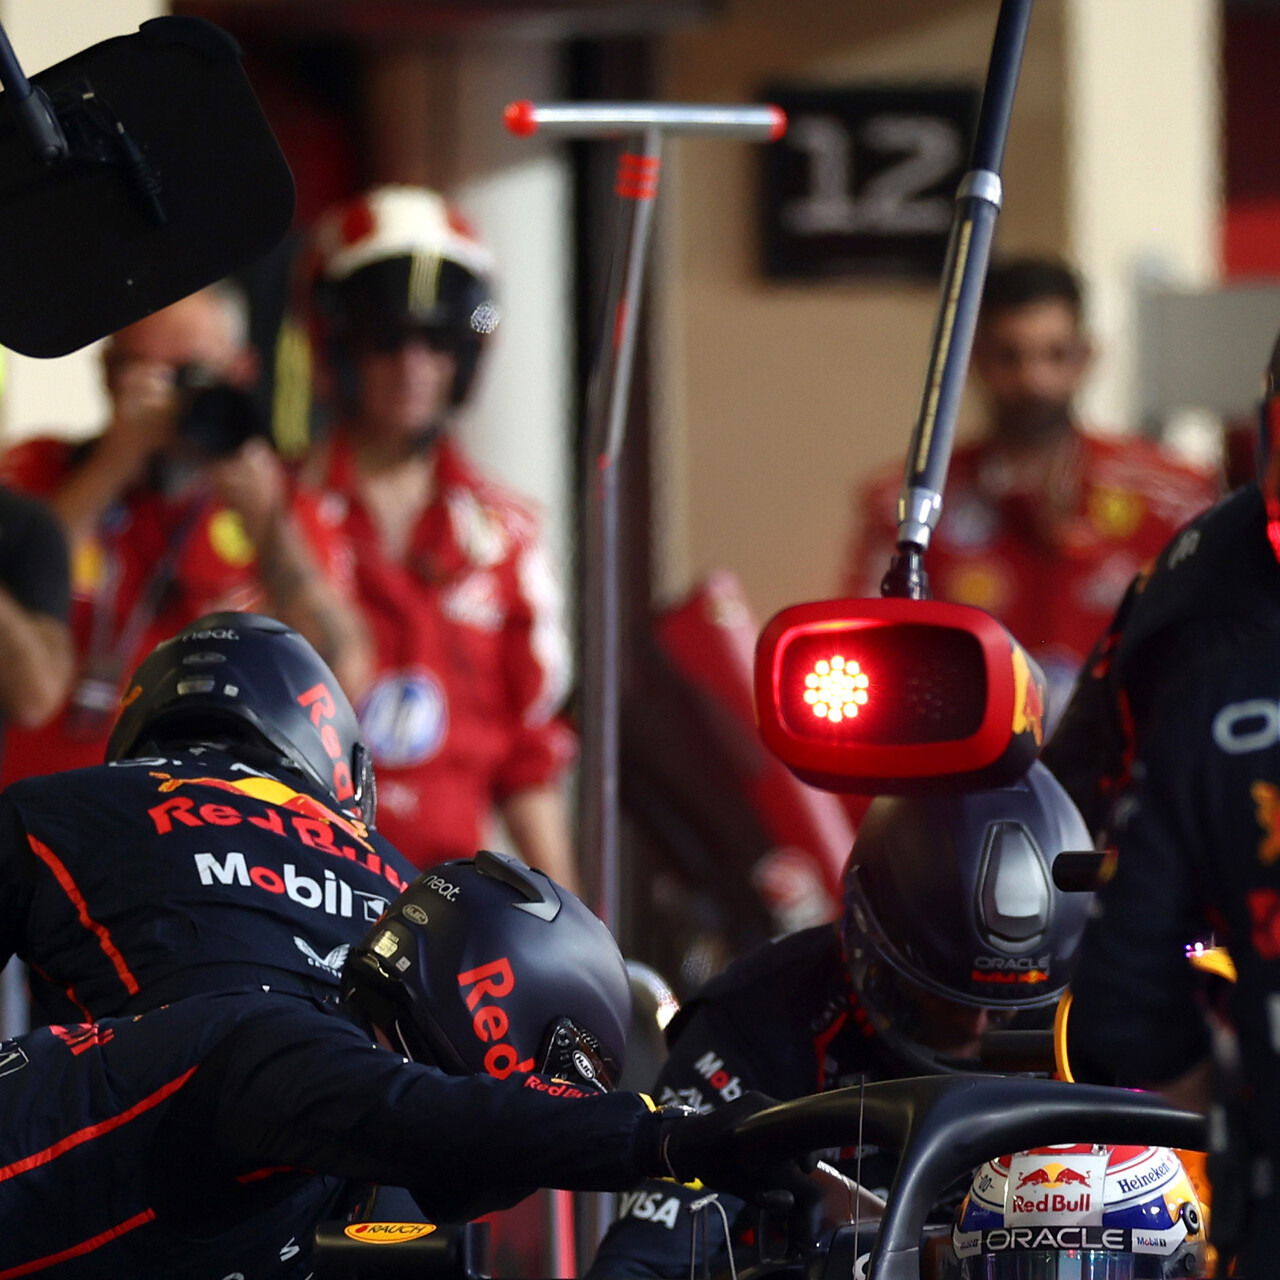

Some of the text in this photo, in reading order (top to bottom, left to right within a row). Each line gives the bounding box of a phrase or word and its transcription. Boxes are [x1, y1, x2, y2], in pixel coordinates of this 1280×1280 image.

[782, 112, 960, 232] 12
[194, 852, 352, 918] Mobil
[422, 873, 459, 902] neat.
[974, 956, 1049, 970] ORACLE
[457, 957, 536, 1081] Red
[524, 1075, 564, 1098] Red
[694, 1051, 742, 1101] Mob
[1116, 1161, 1170, 1193] Heineken
[620, 1191, 680, 1229] VISA
[1012, 1193, 1090, 1213] Red Bull
[368, 1224, 424, 1234] RAUCH
[985, 1228, 1124, 1249] ORACLE
[1137, 1237, 1159, 1247] Mobil
